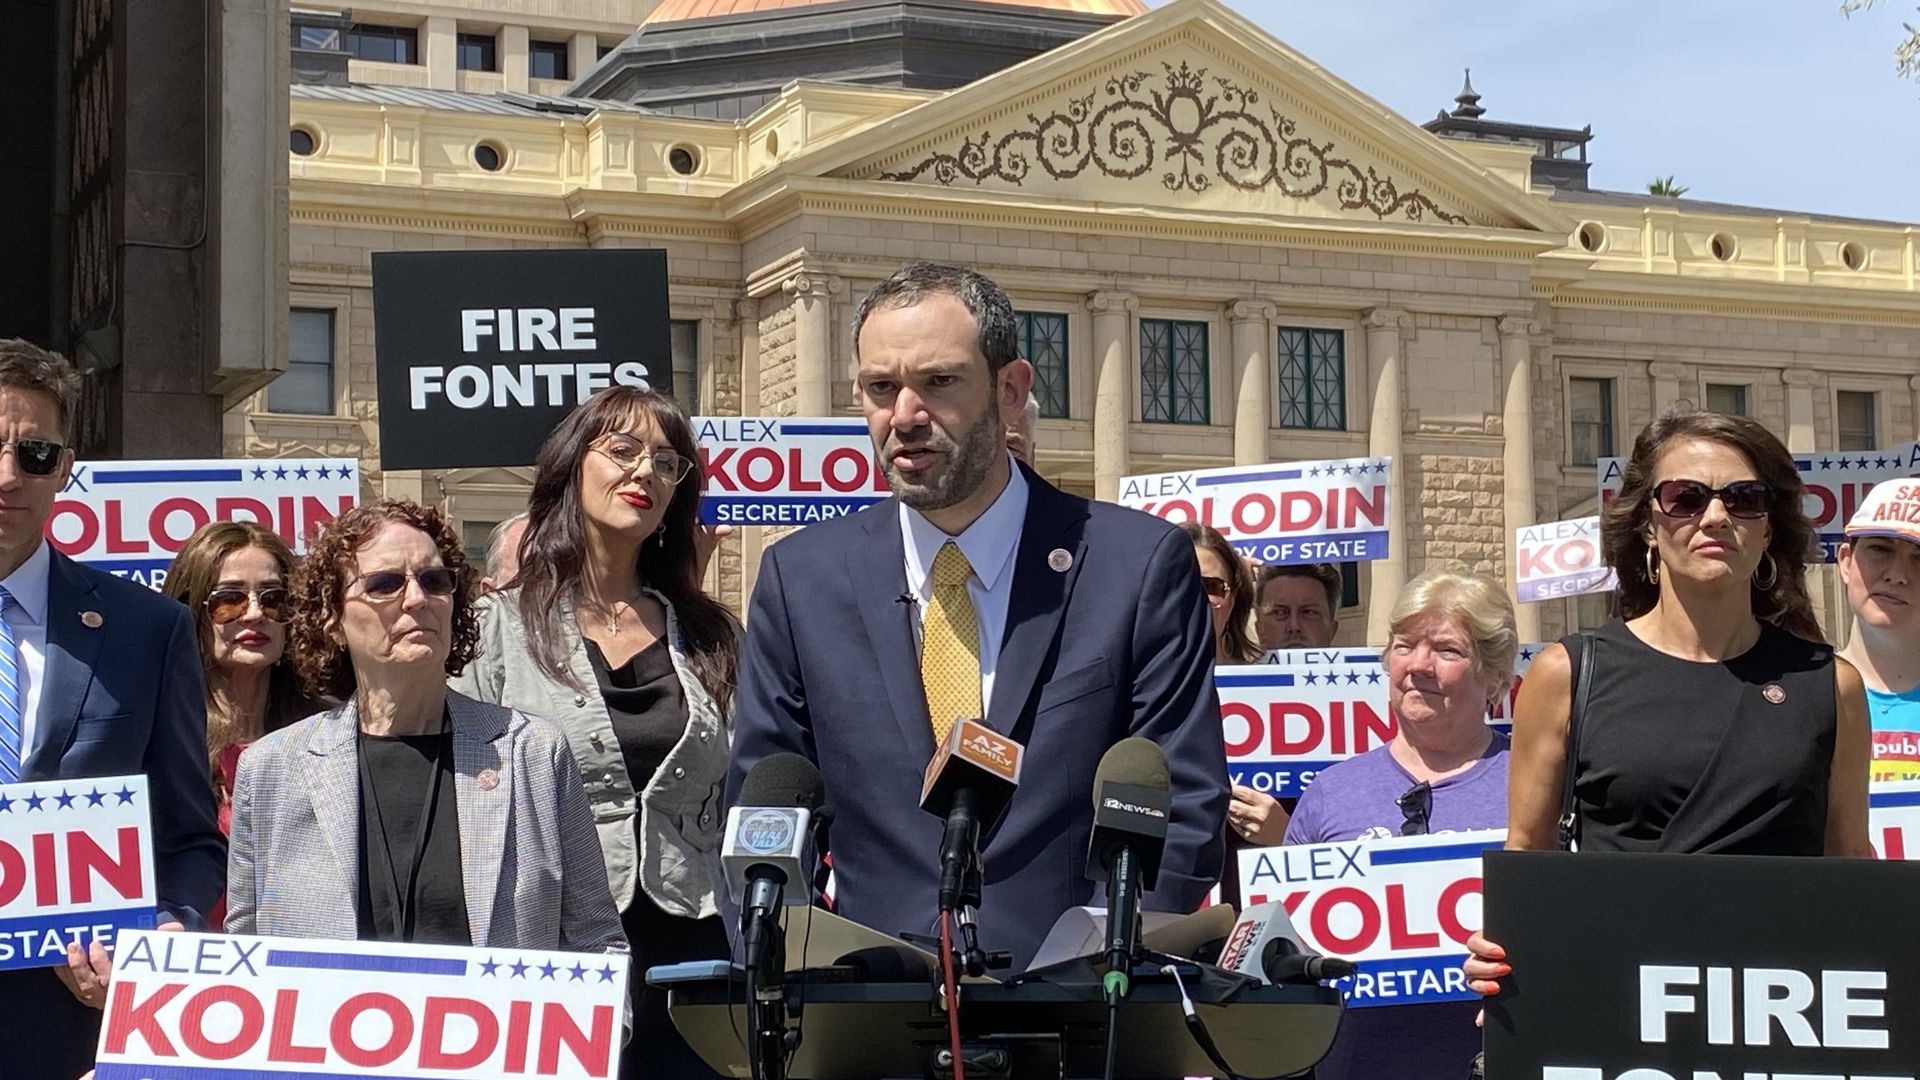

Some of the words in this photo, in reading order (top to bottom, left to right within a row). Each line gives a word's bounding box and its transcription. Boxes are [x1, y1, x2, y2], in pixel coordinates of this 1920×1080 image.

[461, 307, 597, 352] FIRE
[409, 362, 650, 410] FONTES
[699, 420, 777, 442] ALEX
[1123, 474, 1193, 499] ALEX
[1895, 485, 1920, 500] SA
[716, 504, 851, 521] SECRETARY
[1141, 485, 1386, 537] OLODIN
[1872, 502, 1920, 524] ARIZ
[44, 496, 354, 556] OLODIN
[1520, 520, 1589, 545] ALEX
[1263, 544, 1294, 561] OF
[1300, 540, 1366, 559] STATE
[1221, 701, 1398, 756] ODIN
[962, 739, 1013, 766] FAMILY
[973, 735, 1007, 757] AZ
[1252, 772, 1291, 792] OF
[1250, 845, 1366, 885] ALEX
[119, 936, 262, 977] ALEX
[1639, 965, 1890, 1050] FIRE
[103, 981, 615, 1078] KOLODIN
